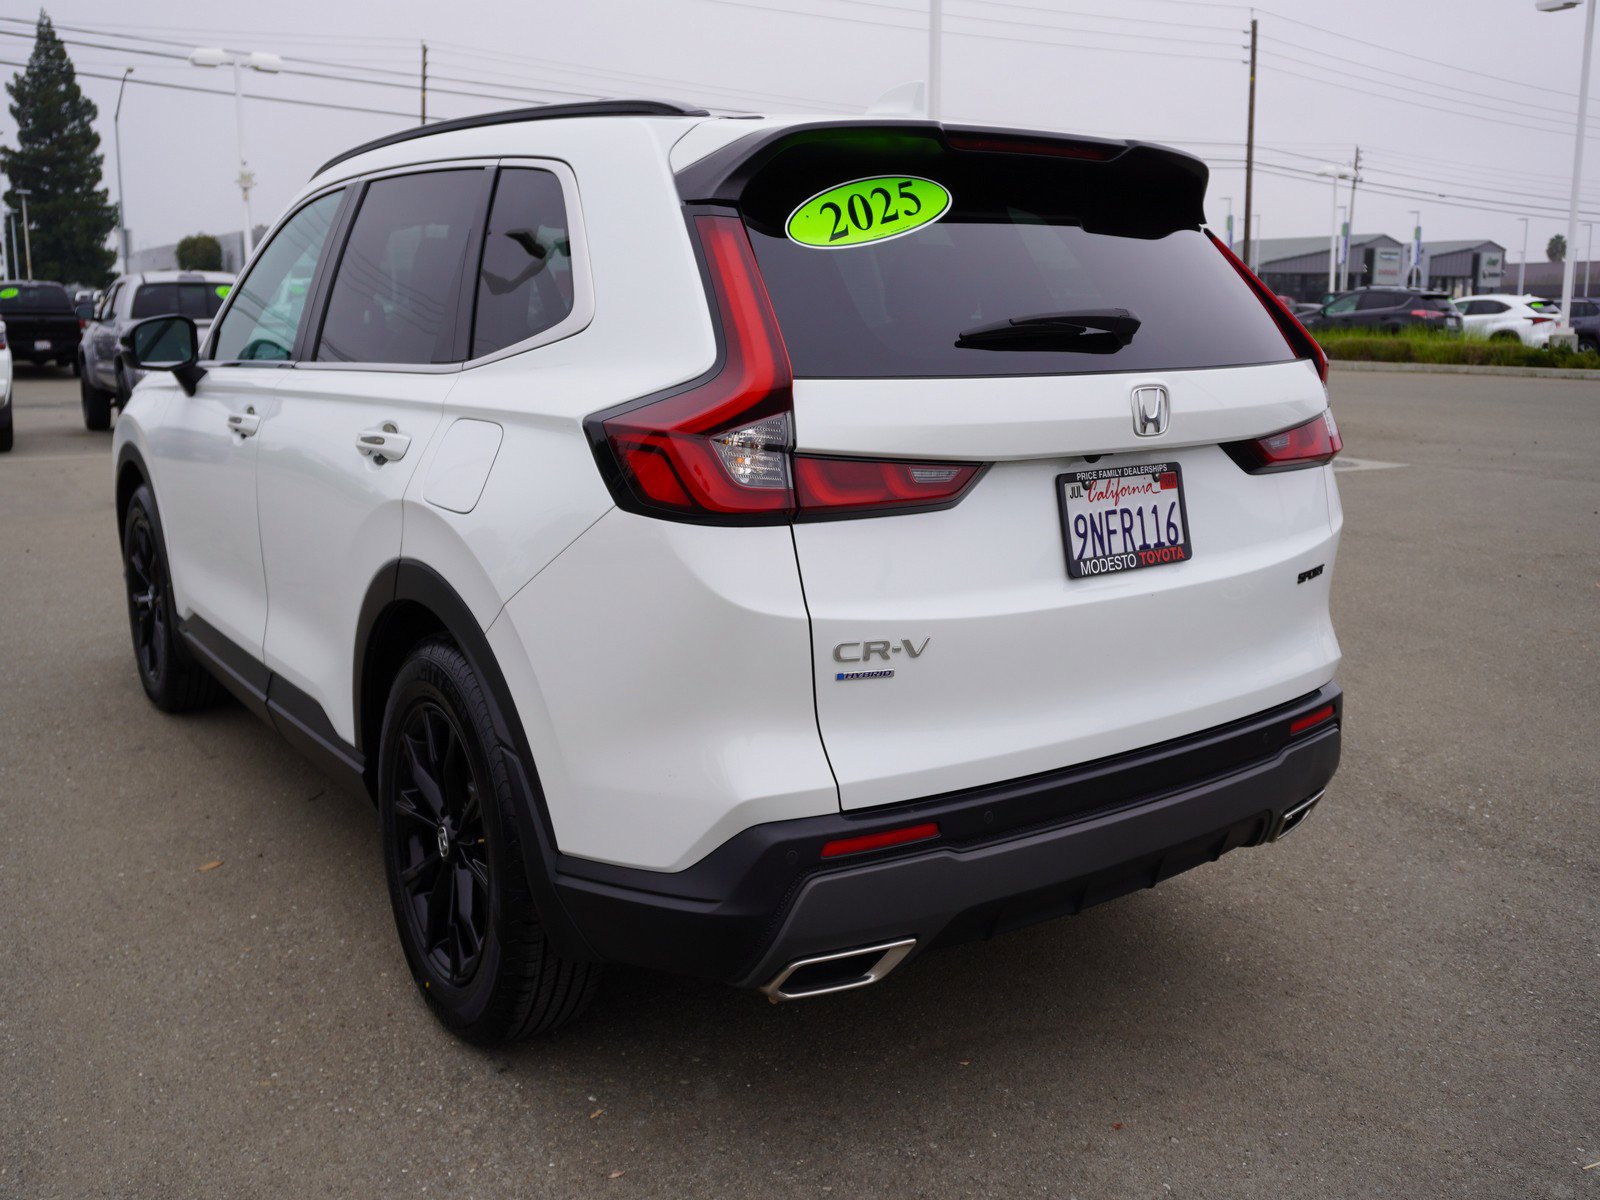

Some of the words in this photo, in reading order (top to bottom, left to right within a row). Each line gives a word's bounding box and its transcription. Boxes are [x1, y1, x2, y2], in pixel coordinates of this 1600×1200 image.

[819, 180, 922, 242] 2025
[1076, 471, 1098, 481] PRICE
[1098, 468, 1122, 479] FAMILY
[1123, 463, 1168, 476] DEALERSHIPS
[1069, 485, 1084, 499] JUL
[1087, 477, 1161, 506] California
[1073, 501, 1180, 561] 9NFR116
[1080, 553, 1137, 576] MODESTO
[1138, 546, 1185, 566] TOYOTA
[832, 636, 931, 663] CR-V
[844, 670, 893, 680] HYBRID
